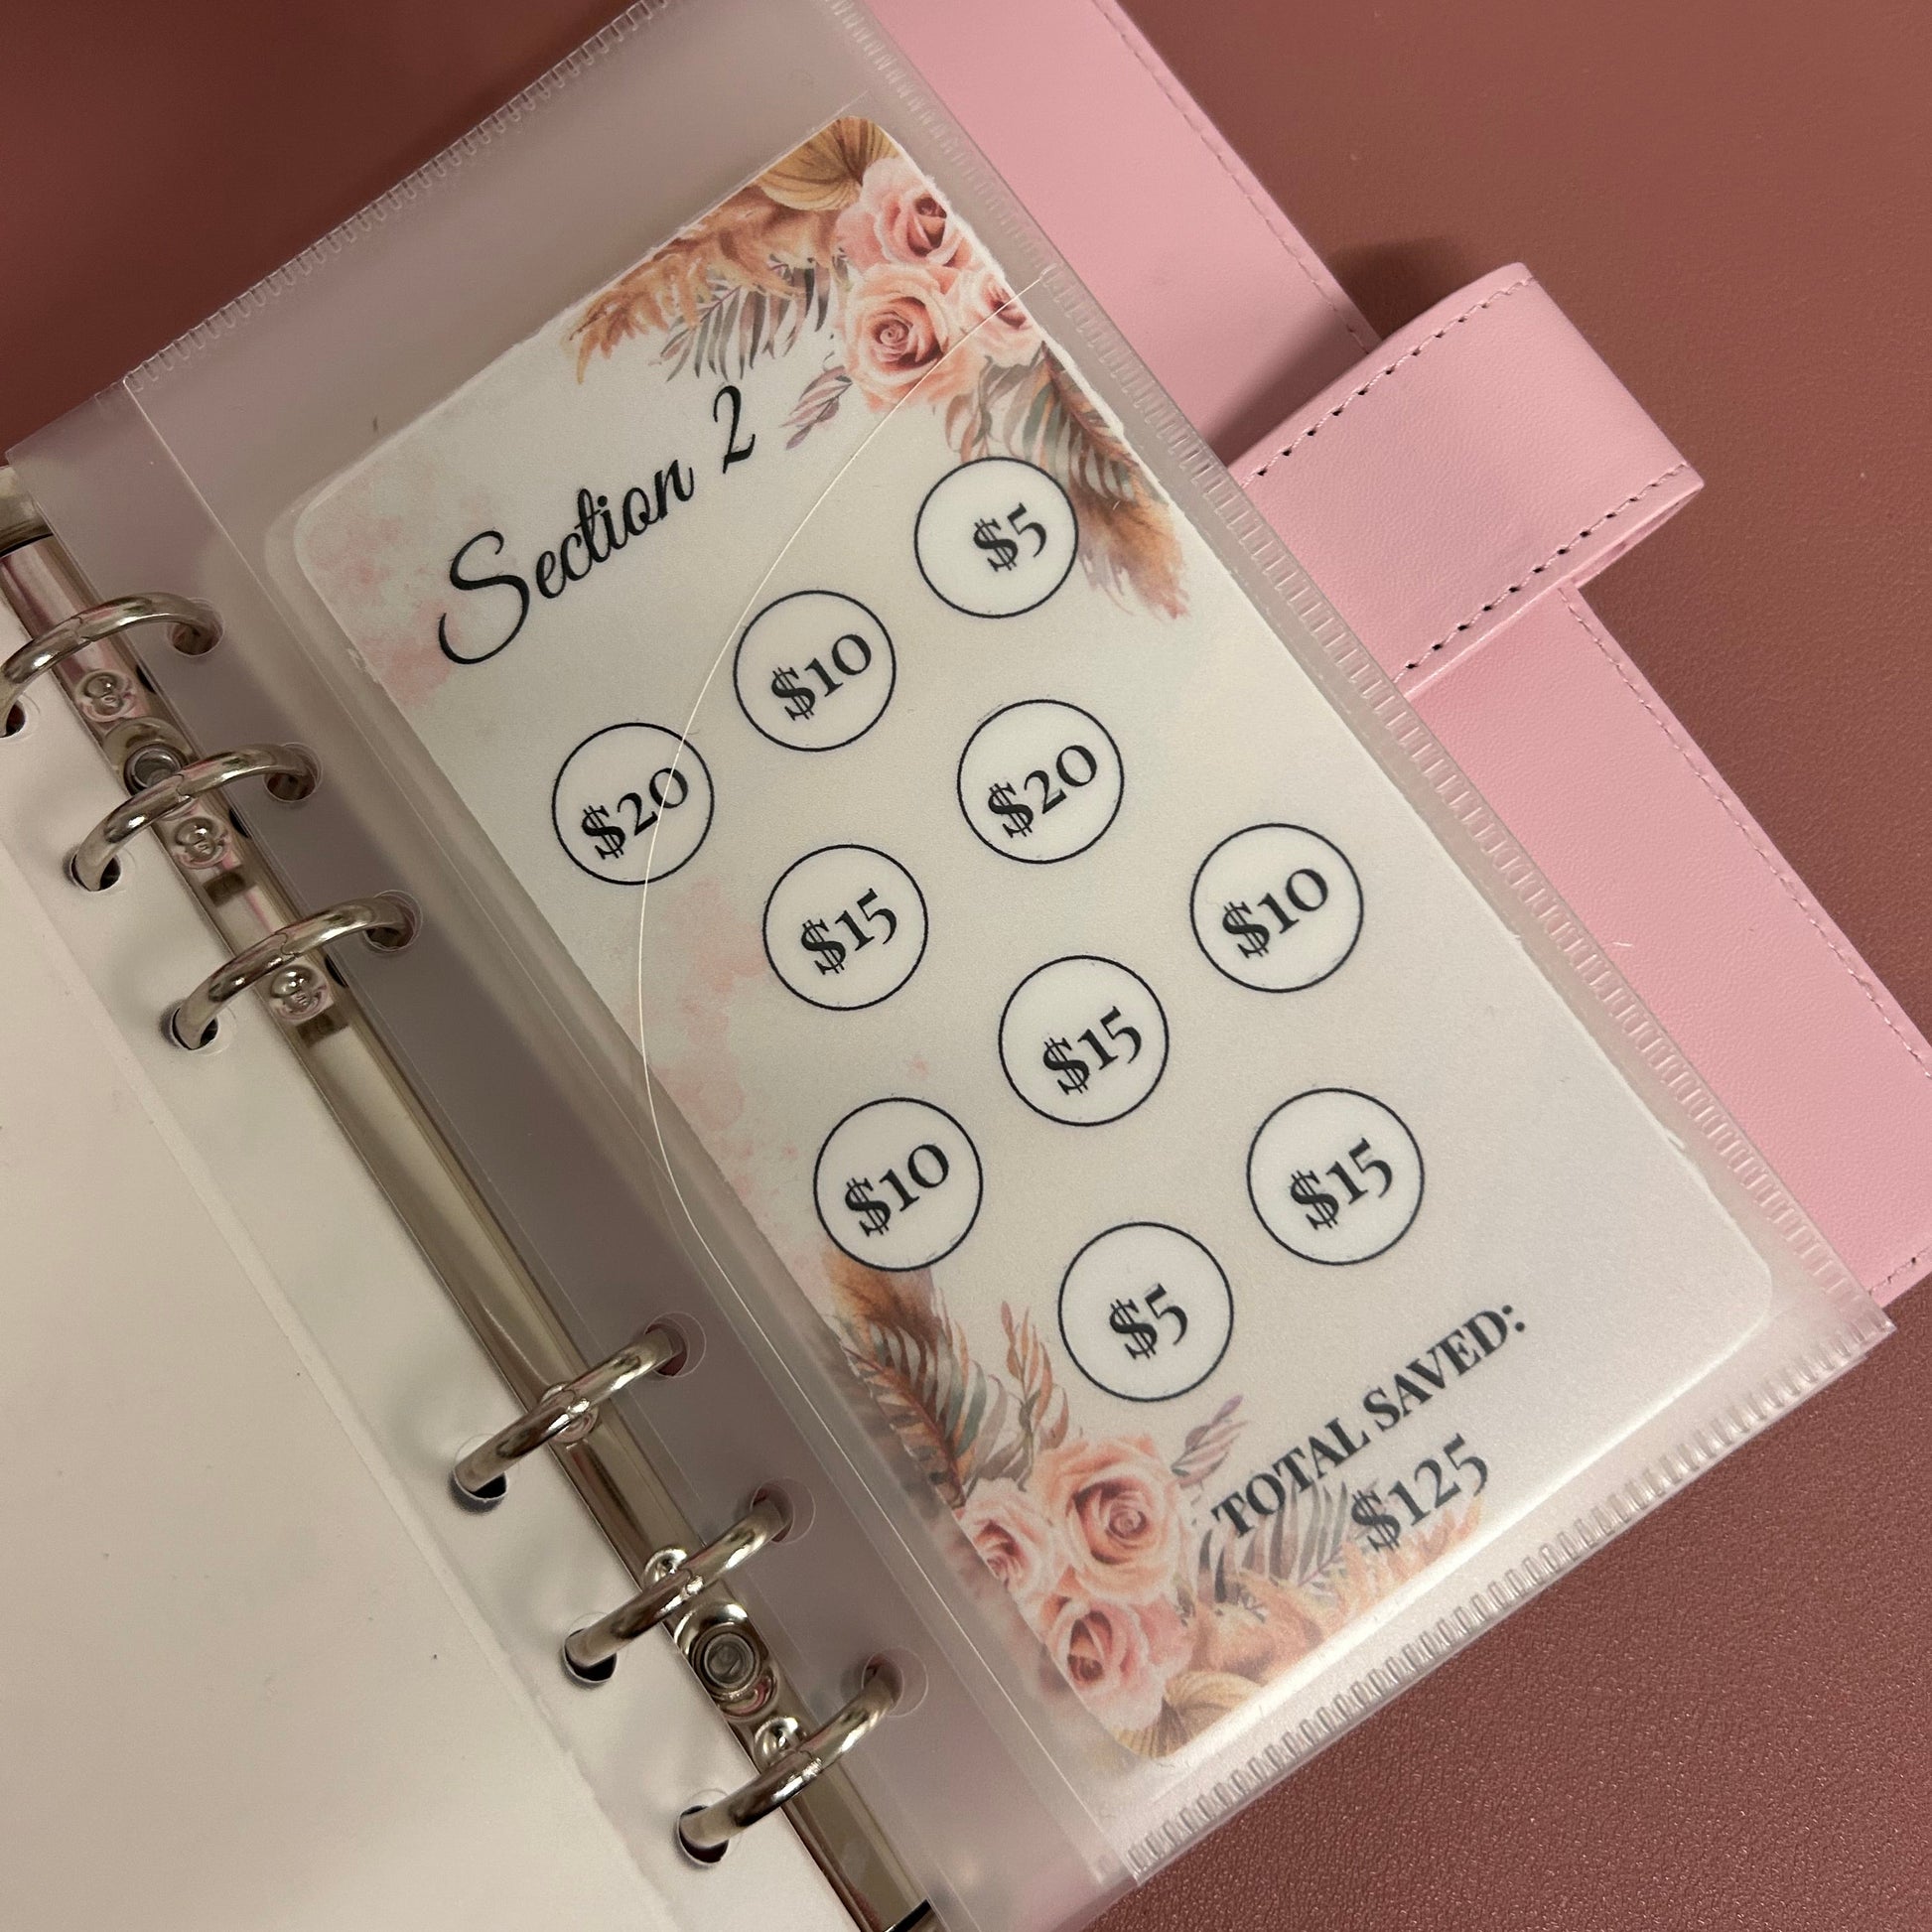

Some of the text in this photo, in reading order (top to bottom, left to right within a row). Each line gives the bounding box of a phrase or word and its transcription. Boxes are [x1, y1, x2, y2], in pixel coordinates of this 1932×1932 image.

[437, 383, 758, 666] Section 2
[972, 501, 1048, 573] $5
[769, 632, 873, 723] $10
[579, 765, 690, 862] $20
[986, 744, 1099, 840] $20
[799, 887, 898, 977] $15
[1221, 867, 1329, 960] $10
[1041, 1005, 1143, 1097] $15
[843, 1143, 951, 1239] $10
[1289, 1136, 1394, 1231] $15
[1108, 1282, 1189, 1361] $5
[1209, 1304, 1526, 1539] TOTAL SAVED:
[1350, 1432, 1489, 1553] $125
